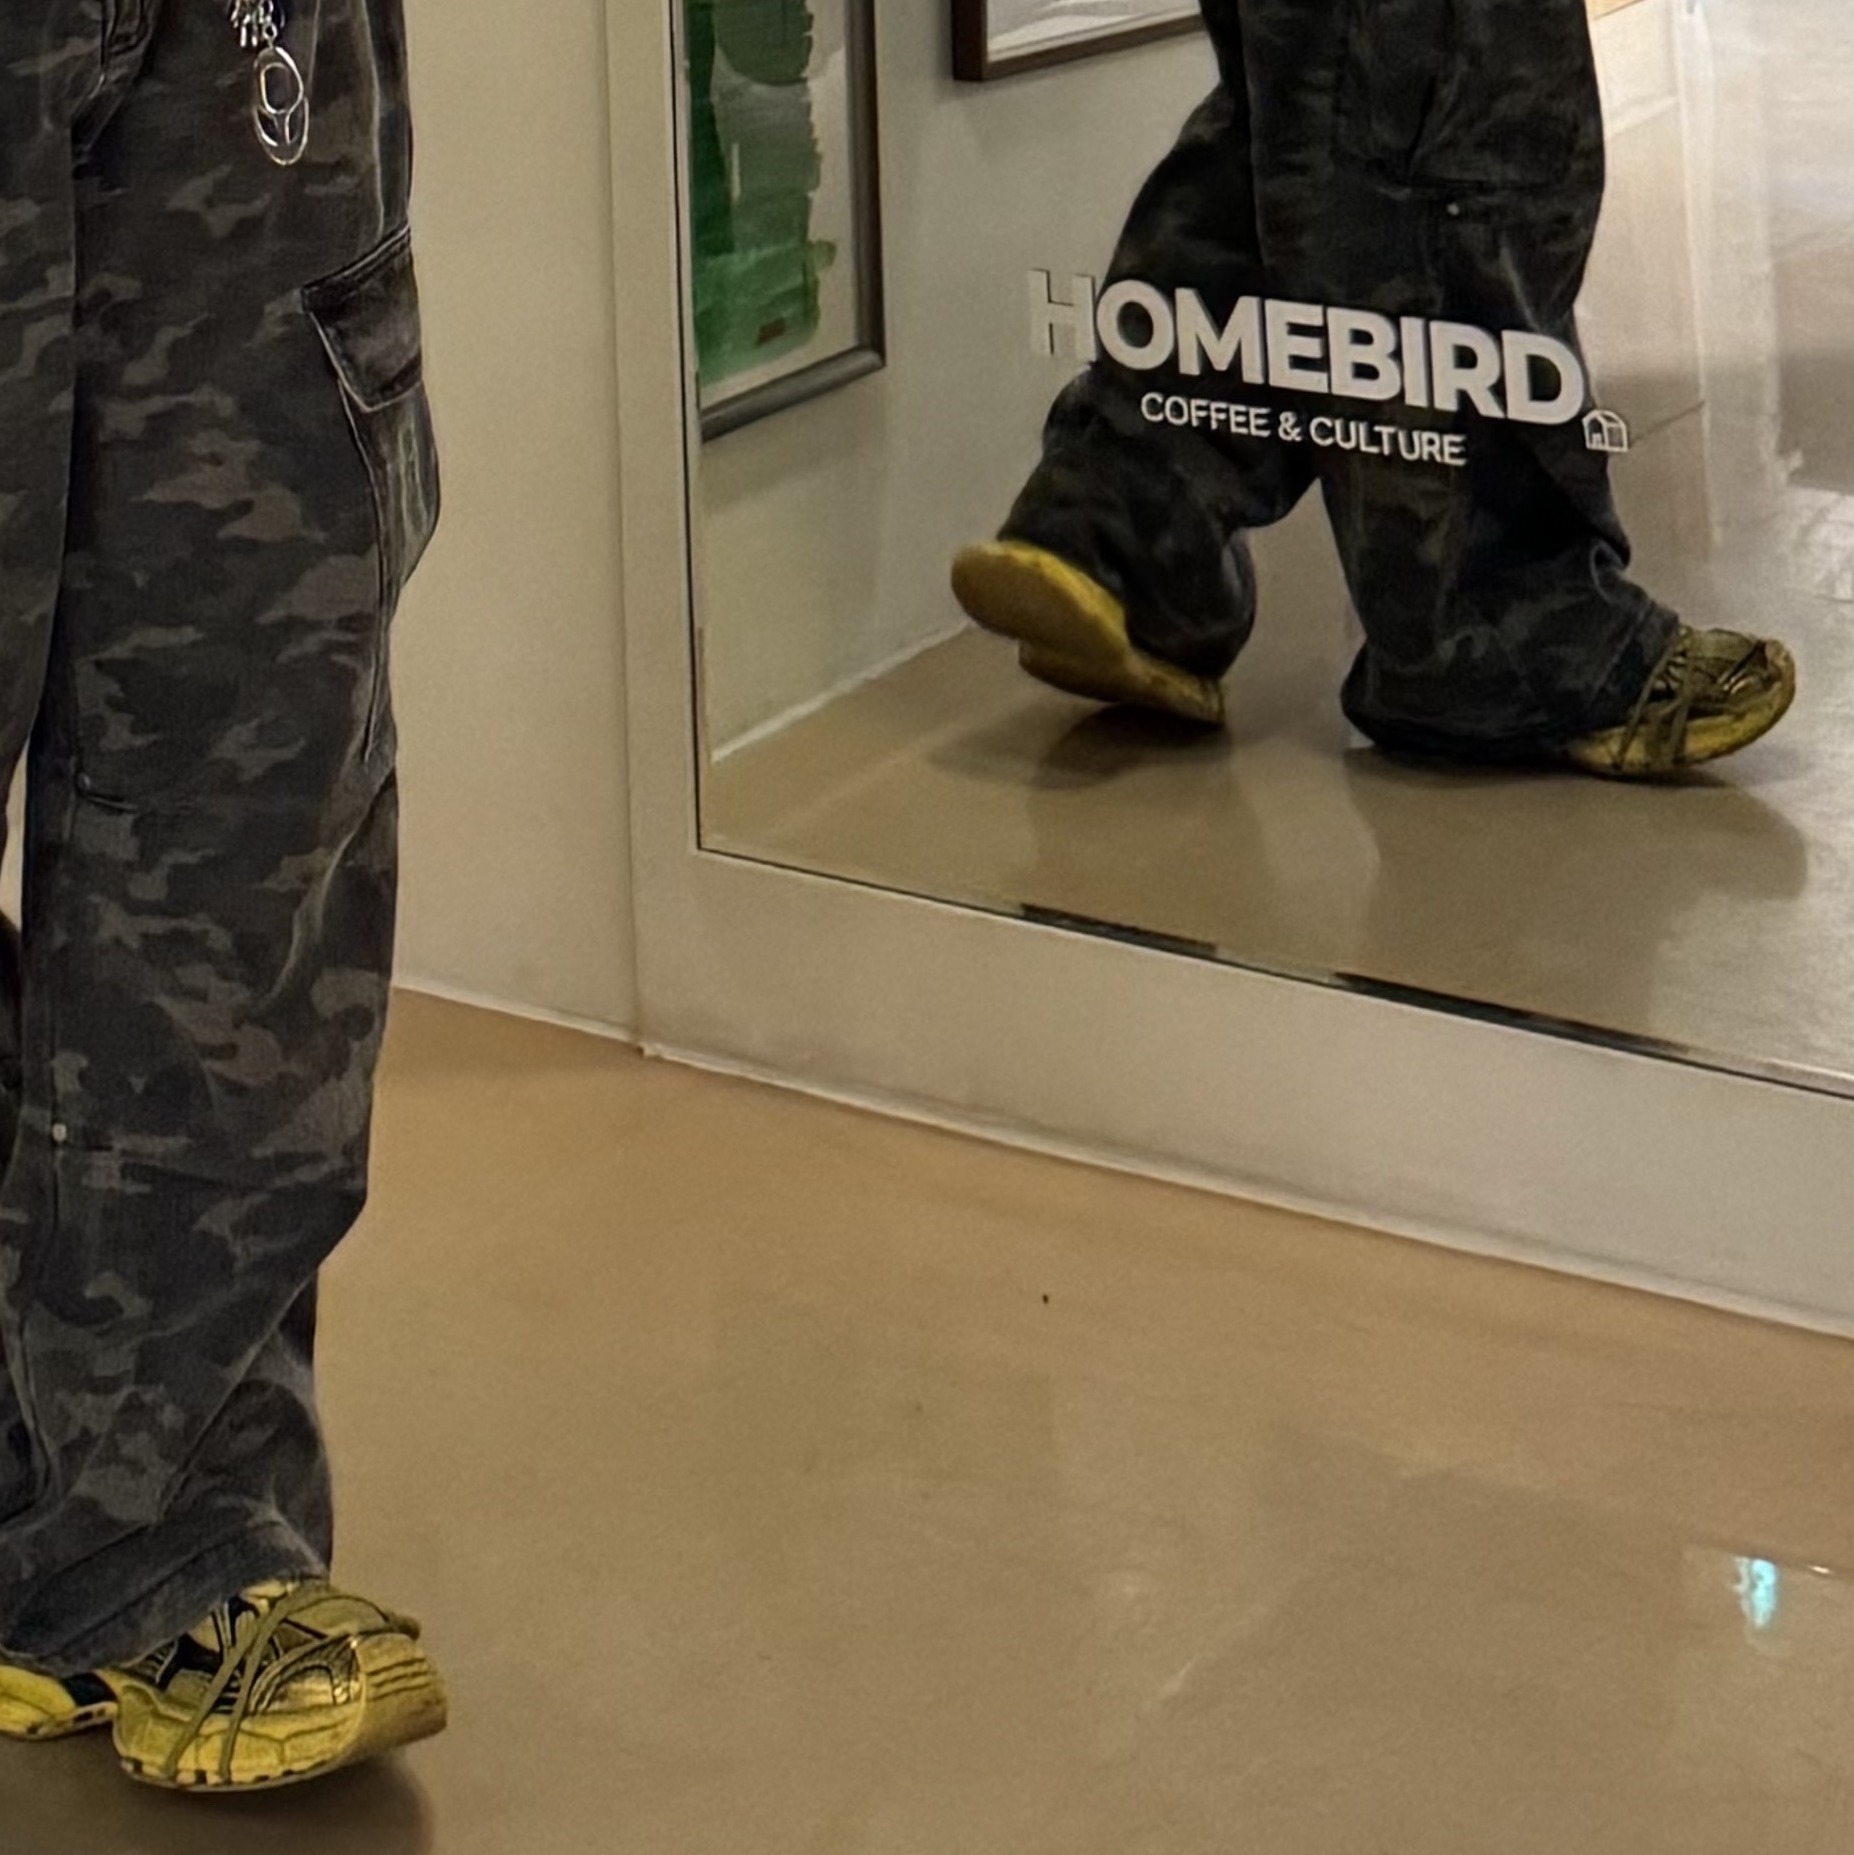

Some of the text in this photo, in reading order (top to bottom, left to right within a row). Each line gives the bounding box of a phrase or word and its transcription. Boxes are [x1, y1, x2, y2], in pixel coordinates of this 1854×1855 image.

[1027, 267, 1587, 426] HOMEBIRD
[1140, 391, 1467, 467] COFFEE & CULTURE
